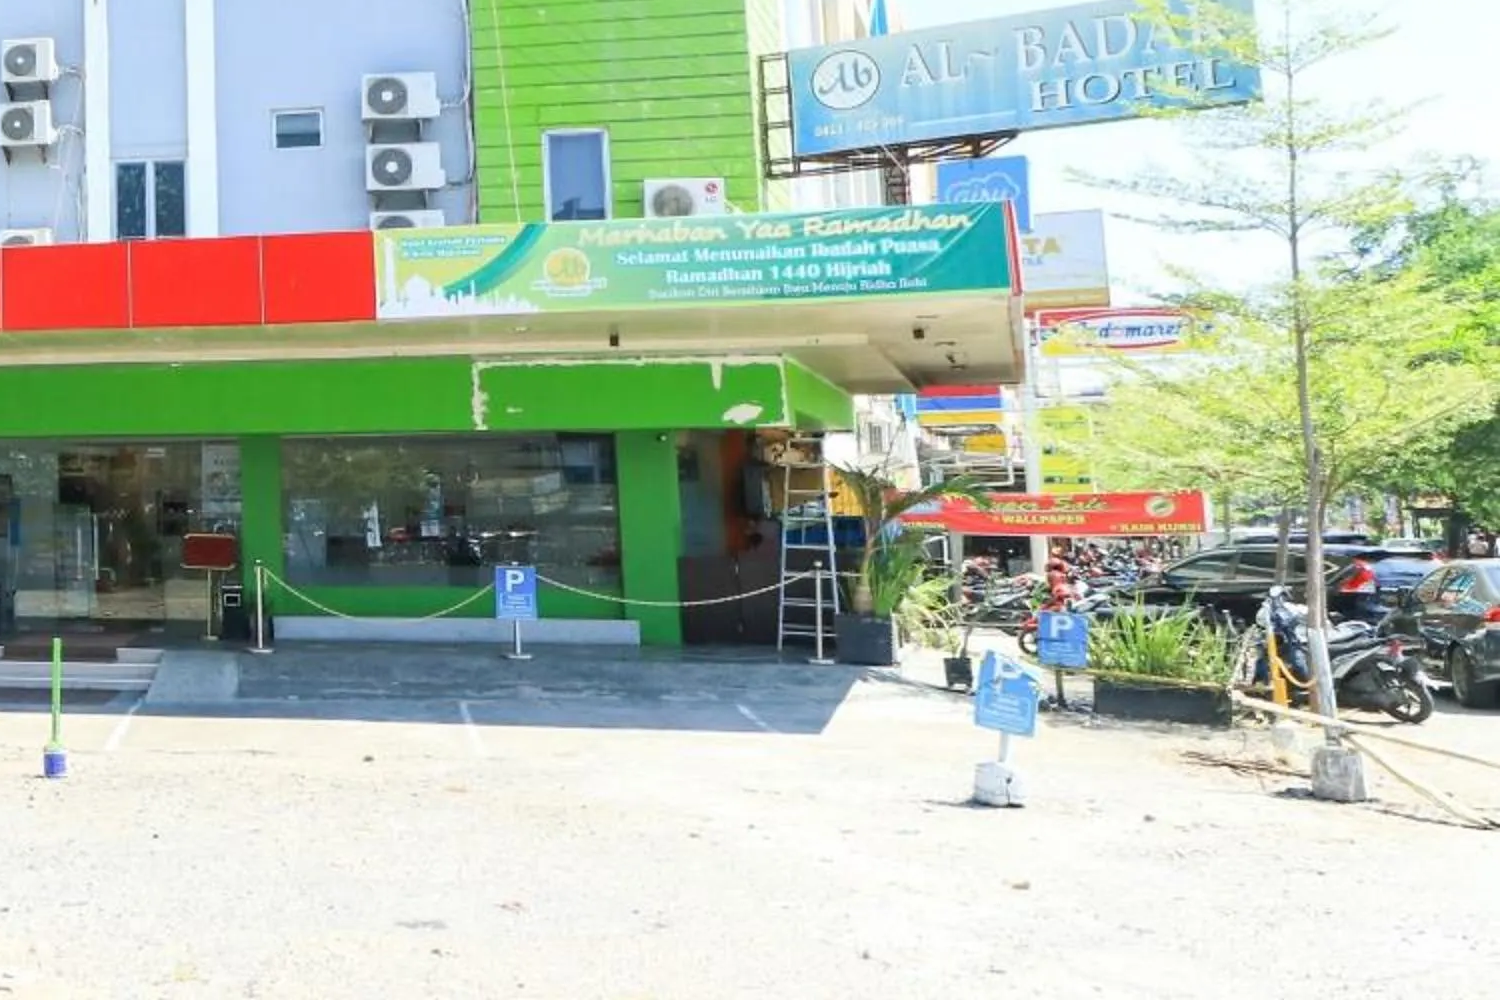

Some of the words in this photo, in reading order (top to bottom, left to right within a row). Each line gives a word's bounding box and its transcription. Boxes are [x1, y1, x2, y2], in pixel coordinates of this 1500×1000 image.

[1030, 58, 1237, 113] HOTEL
[578, 221, 727, 247] Marhaban
[736, 219, 792, 240] Yaa
[803, 209, 971, 237] Ramadhan
[616, 249, 689, 266] Selamat
[694, 243, 805, 262] Menunaikan
[666, 266, 763, 284] Ramadhan
[771, 264, 820, 280] 1440
[826, 260, 891, 278] Hijriah
[505, 569, 525, 593] P
[1051, 614, 1074, 639] P
